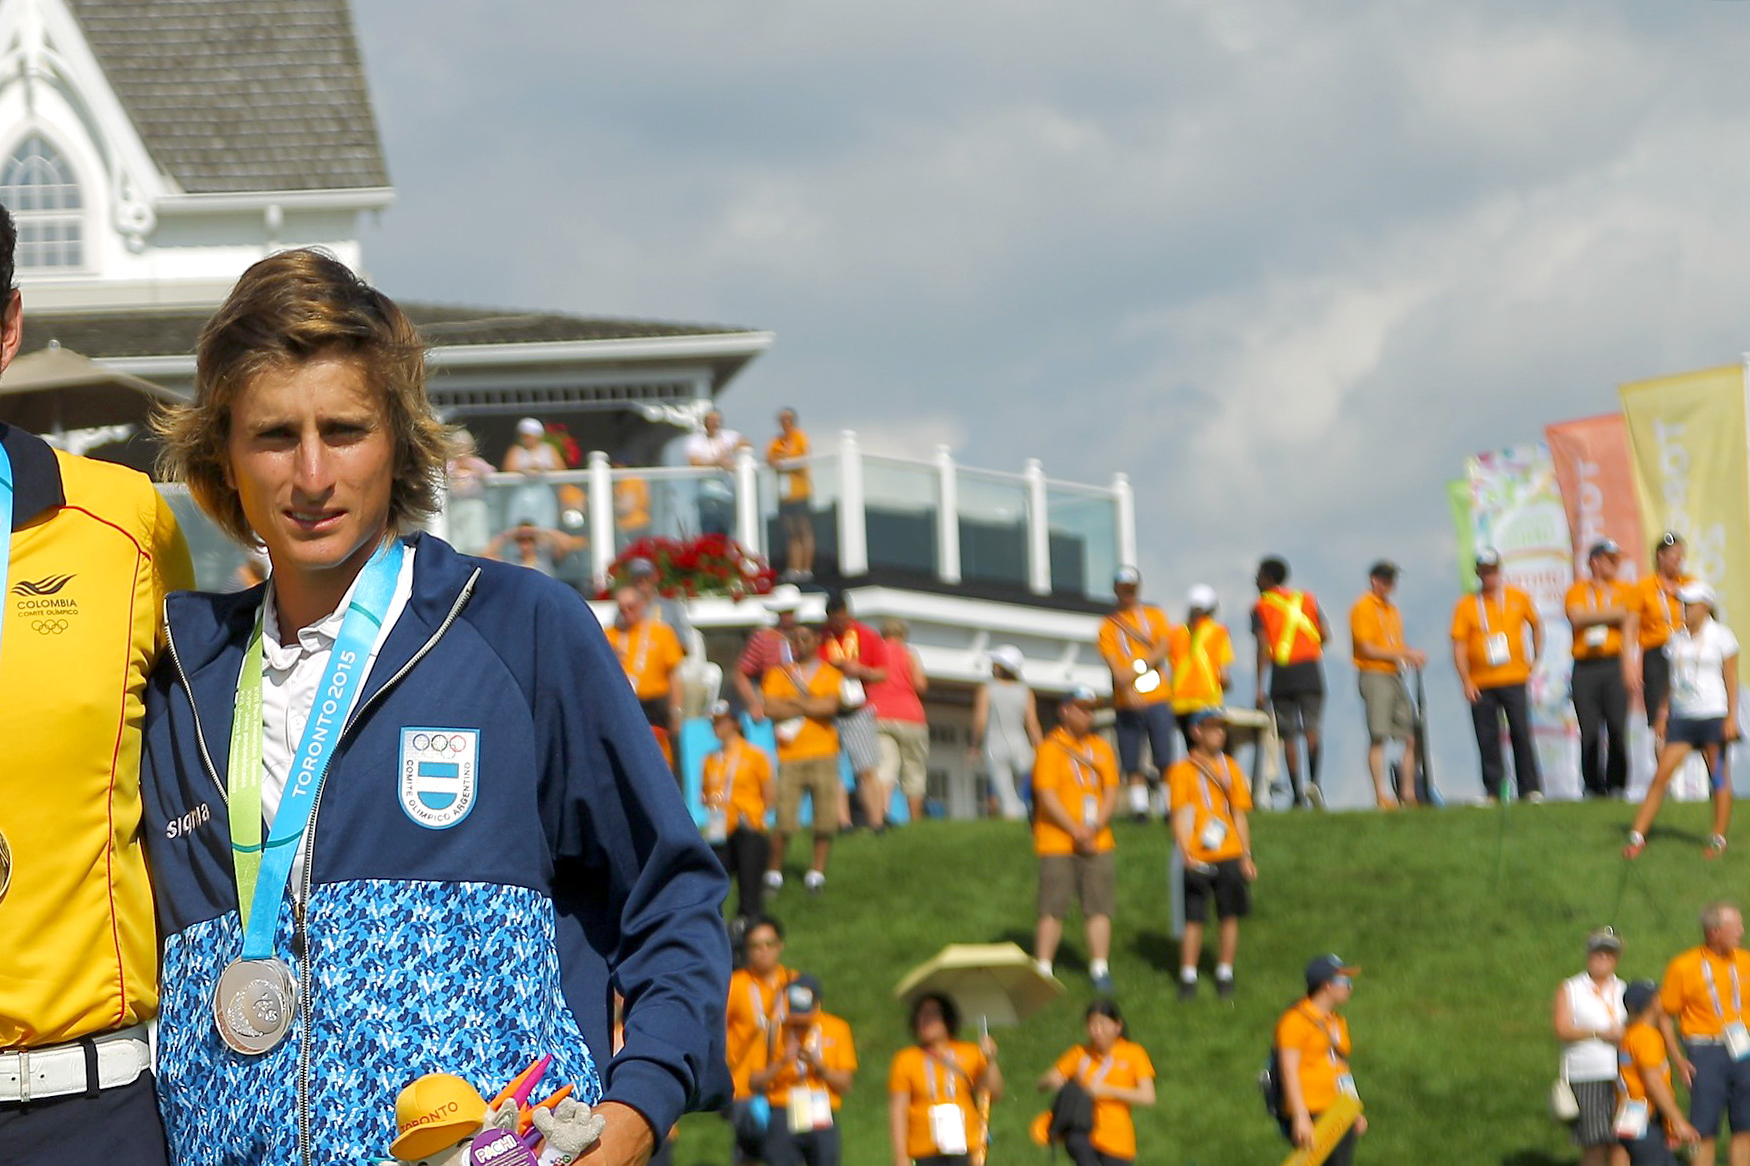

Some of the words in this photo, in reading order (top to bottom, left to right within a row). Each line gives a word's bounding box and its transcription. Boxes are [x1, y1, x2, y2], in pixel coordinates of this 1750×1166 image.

[17, 598, 78, 610] COLOMBIA
[453, 761, 472, 816] ARGENTINO
[474, 1133, 519, 1164] PACHI
